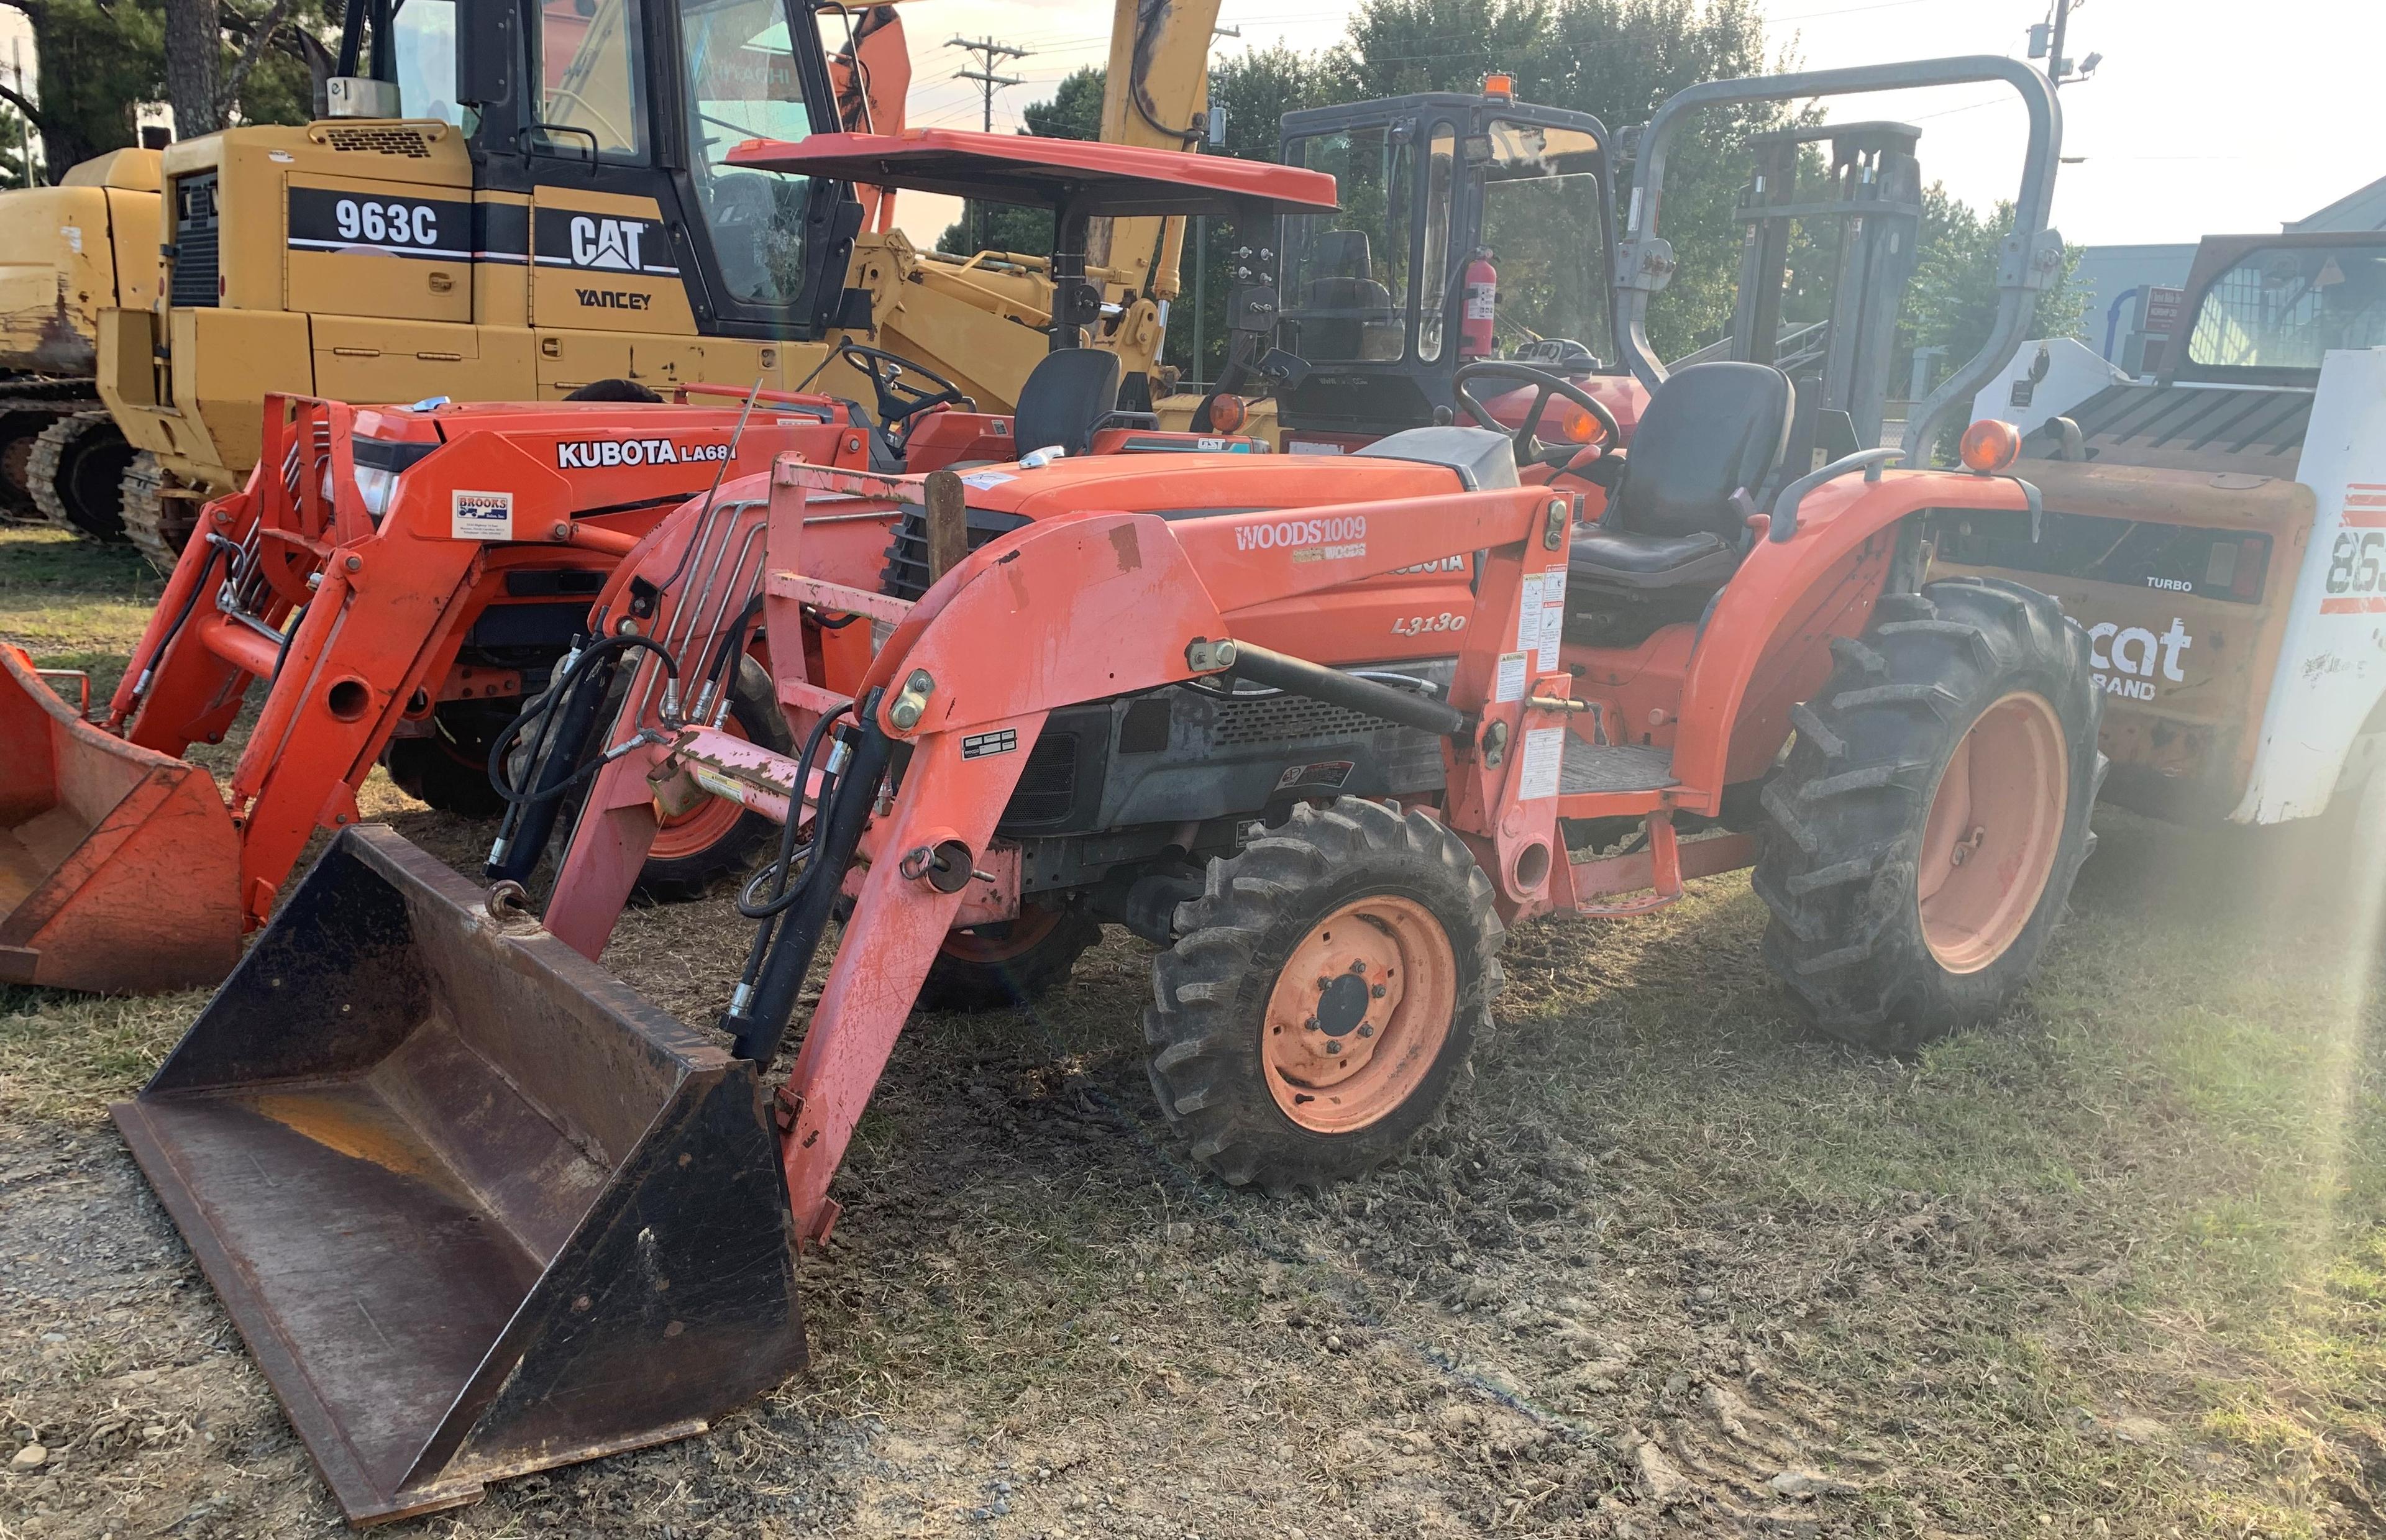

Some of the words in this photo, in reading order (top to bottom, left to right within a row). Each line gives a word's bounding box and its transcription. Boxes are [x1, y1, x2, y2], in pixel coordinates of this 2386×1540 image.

[336, 199, 437, 245] 963C
[570, 216, 644, 271] CAT
[575, 288, 651, 311] YANCEY
[557, 439, 679, 469] KUBOTA
[1198, 437, 1226, 450] GST
[459, 497, 506, 508] BROOKS
[2326, 531, 2386, 594] 86
[2147, 576, 2192, 591] TURBO
[1390, 612, 1466, 637] L3130
